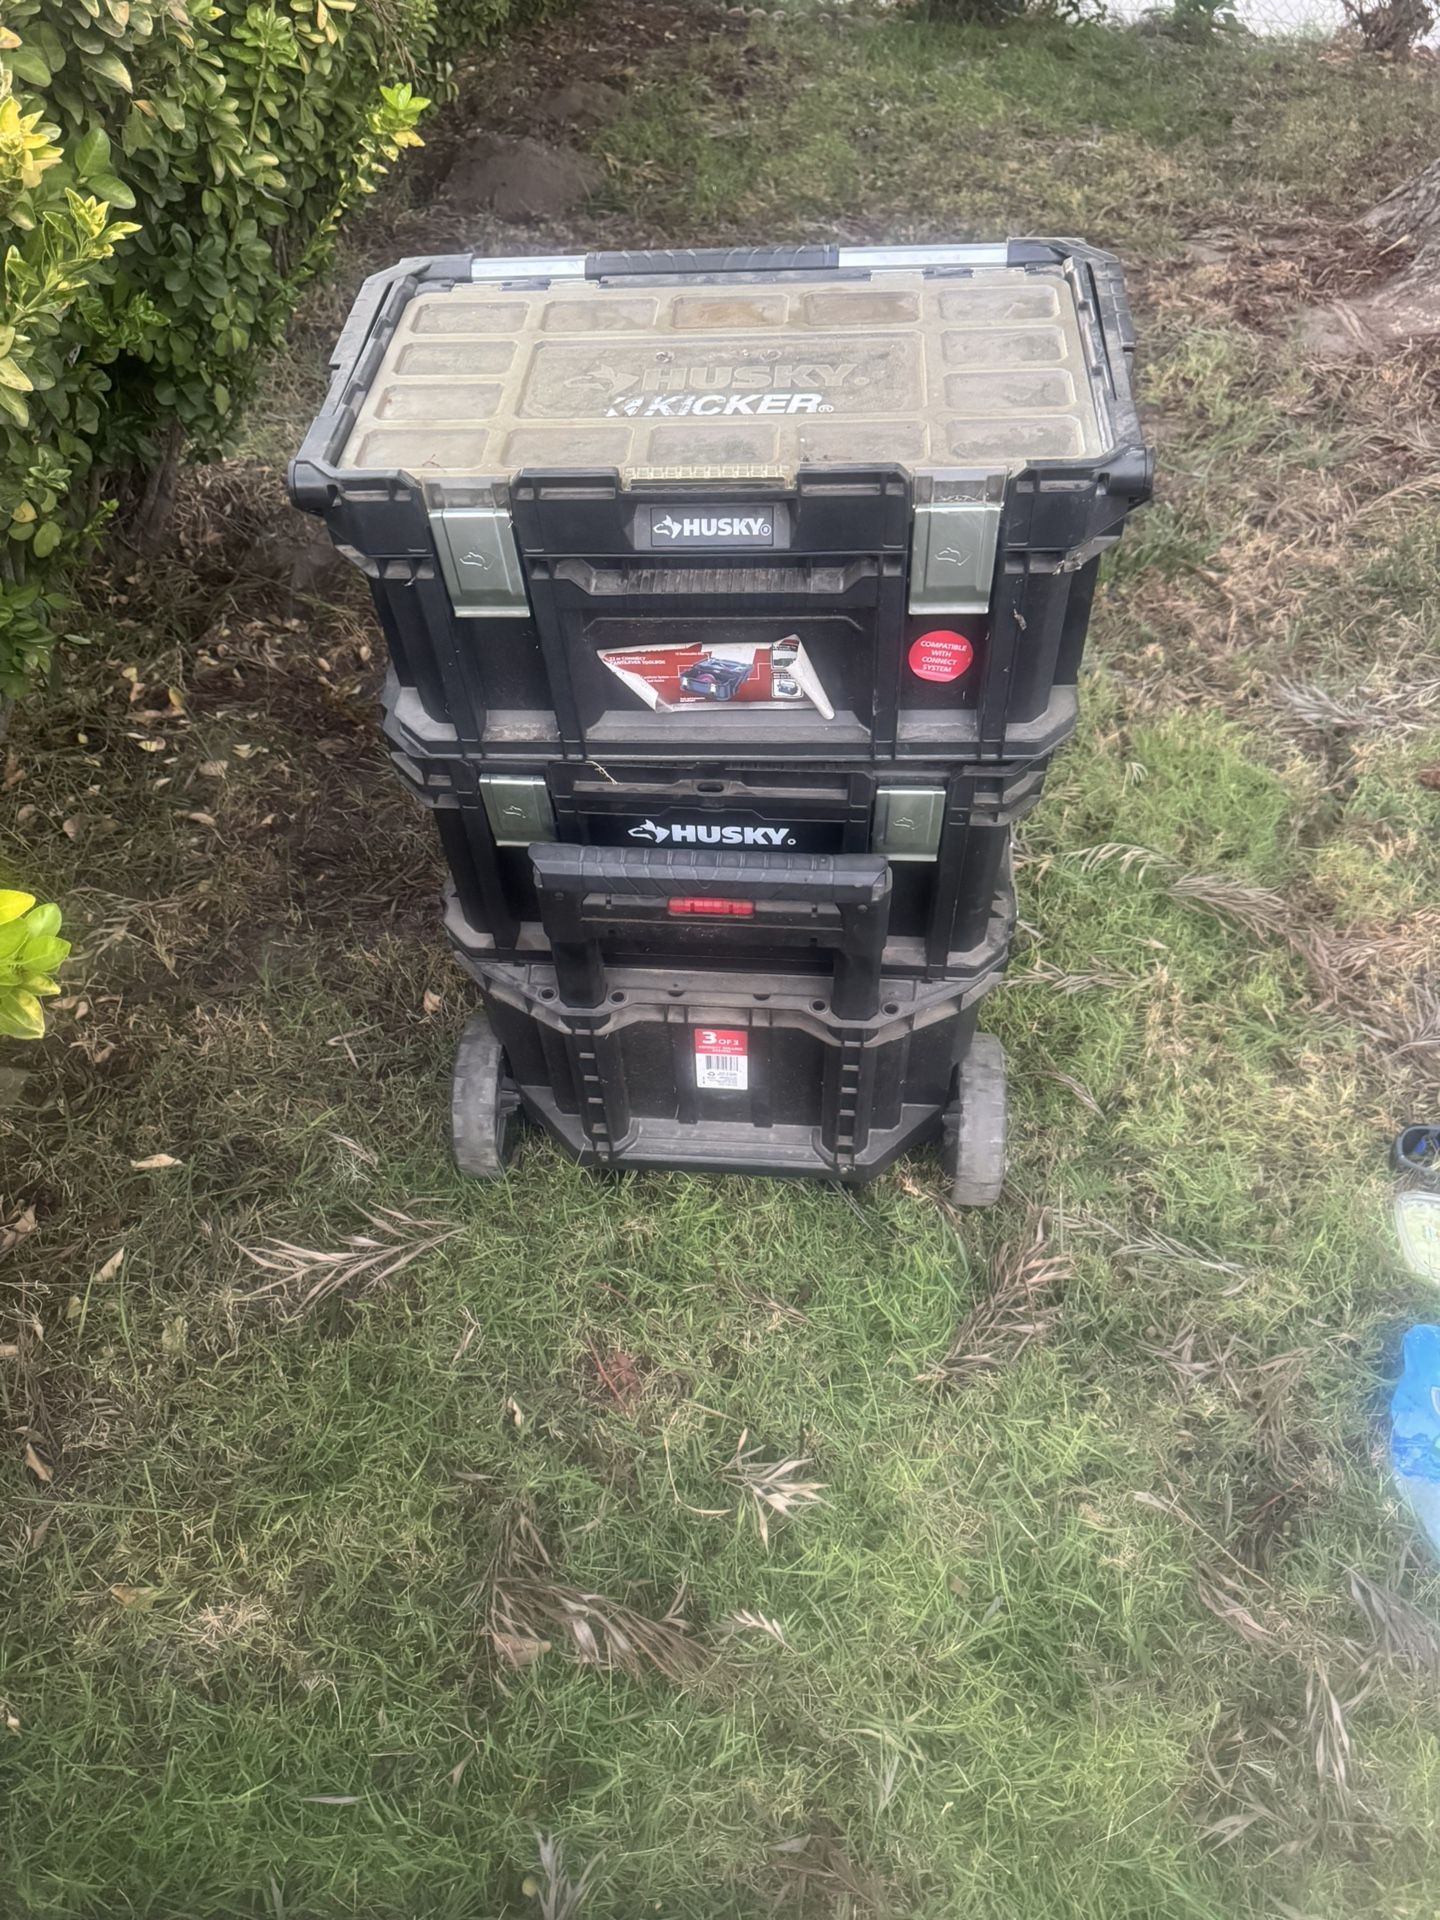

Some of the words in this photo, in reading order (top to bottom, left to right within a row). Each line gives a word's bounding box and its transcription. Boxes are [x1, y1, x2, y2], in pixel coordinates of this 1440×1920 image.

[920, 640, 967, 651] COMPATIBLE
[931, 649, 952, 658] WITH
[921, 656, 957, 665] CONNECT
[922, 664, 952, 672] SYSTEM
[702, 1031, 717, 1045] 3
